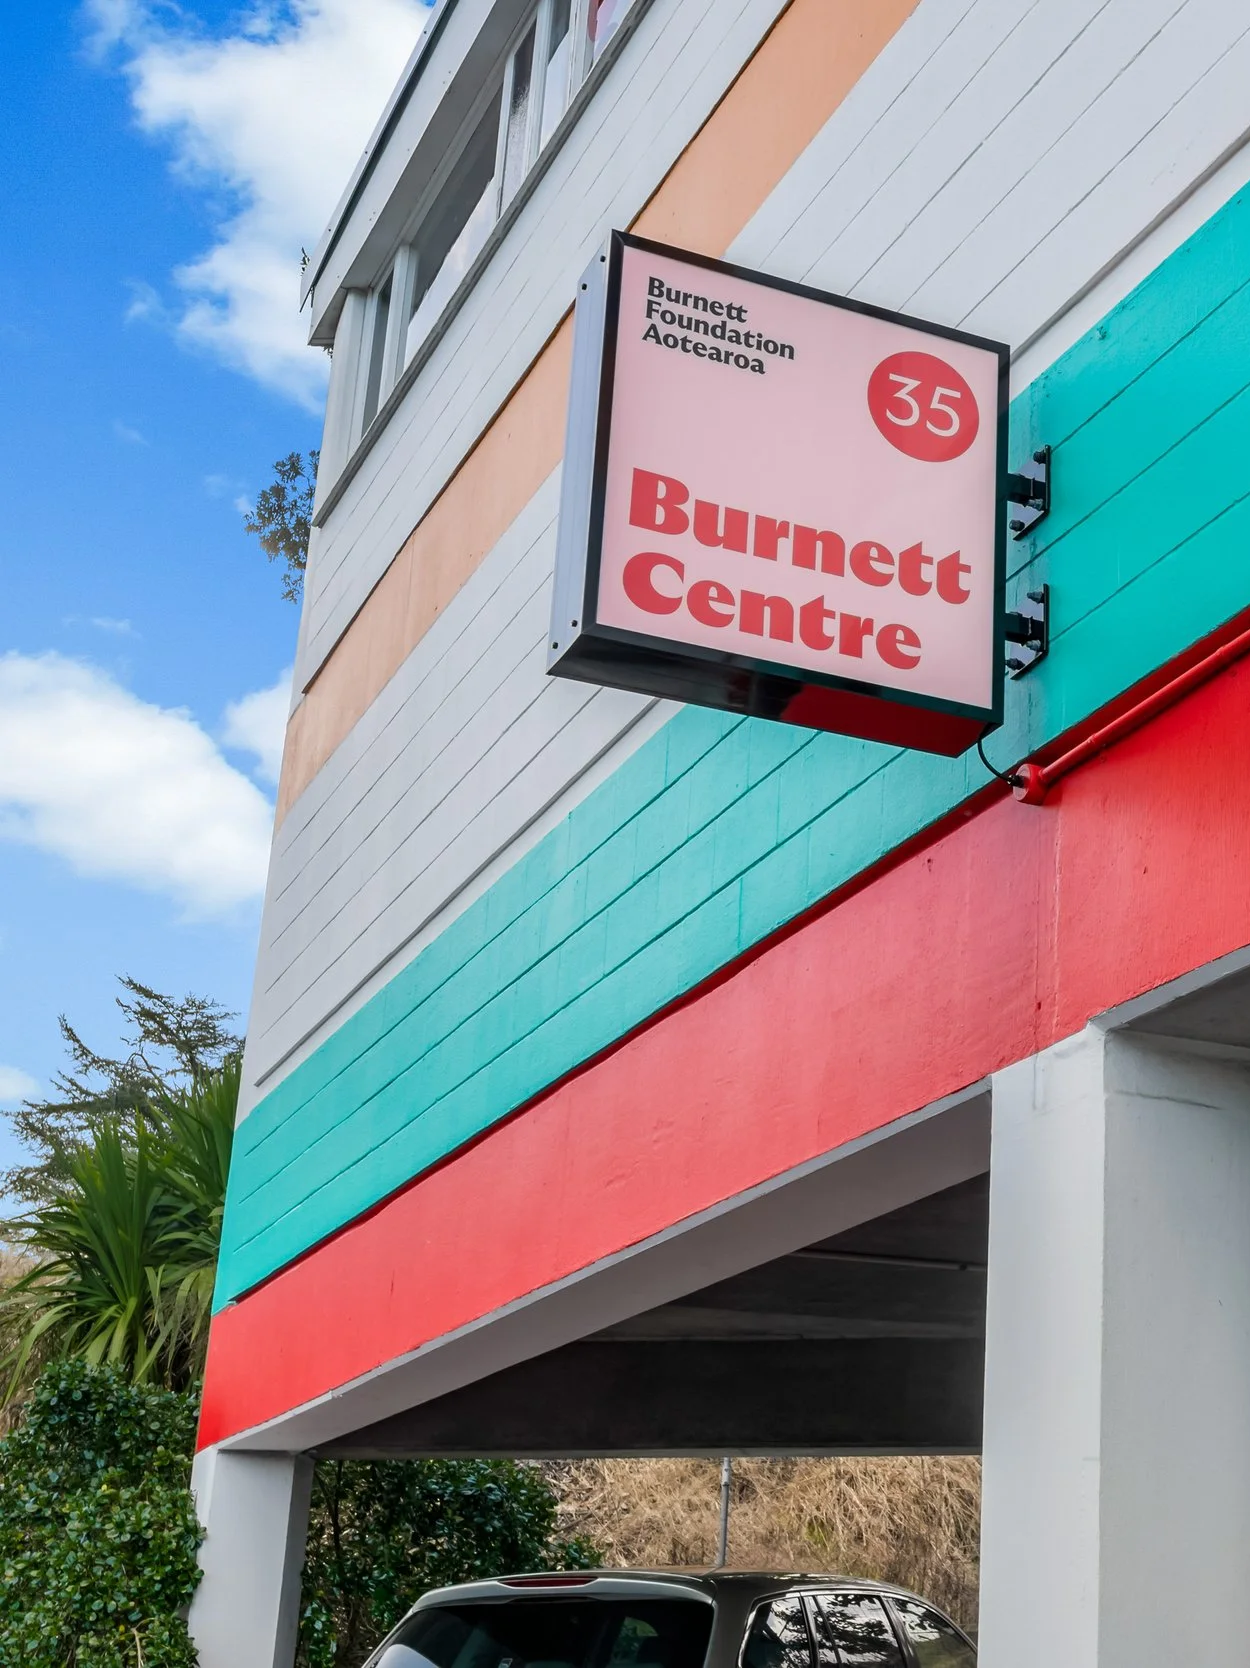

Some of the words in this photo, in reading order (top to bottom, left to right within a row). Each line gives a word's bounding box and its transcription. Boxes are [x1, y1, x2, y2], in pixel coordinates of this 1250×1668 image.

[645, 299, 796, 361] Foundation
[647, 275, 749, 324] Burnett
[641, 323, 766, 375] Aotearoa
[886, 372, 962, 438] 35
[628, 466, 972, 605] Burnett
[622, 551, 922, 670] Centre
